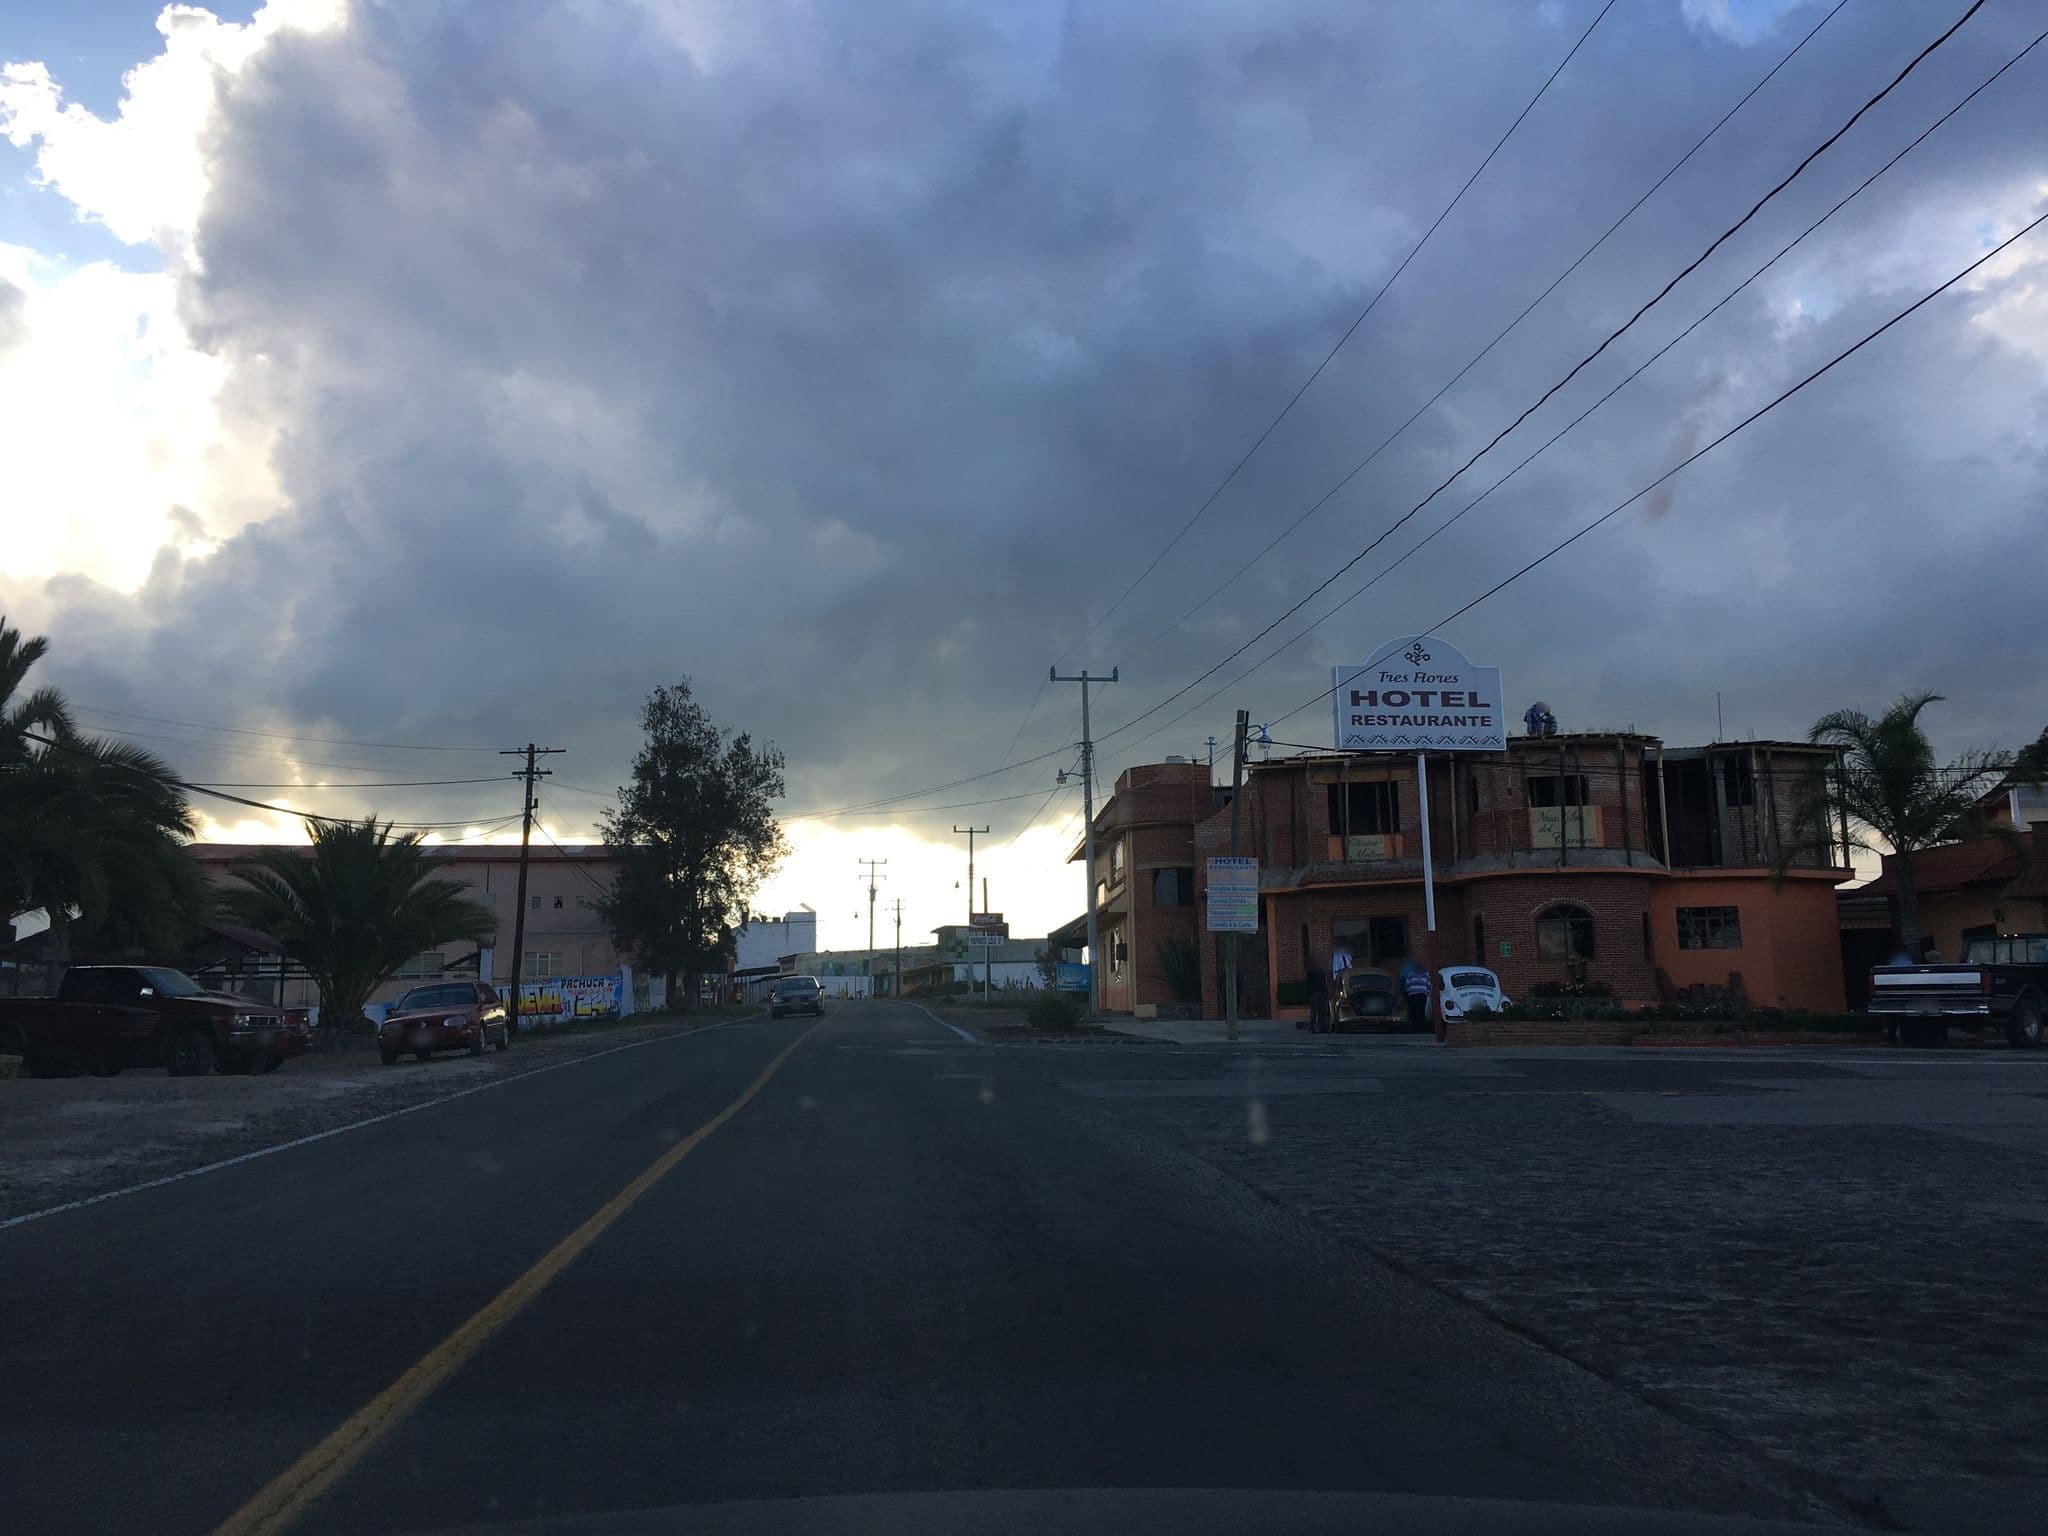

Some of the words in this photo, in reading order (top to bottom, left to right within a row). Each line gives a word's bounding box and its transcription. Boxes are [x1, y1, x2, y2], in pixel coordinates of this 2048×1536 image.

[1379, 671, 1409, 683] Tres
[1414, 671, 1459, 684] Flores
[1350, 690, 1491, 708] HOTEL
[1351, 714, 1492, 727] RESTAURANTE
[561, 978, 604, 990] PACHUCA
